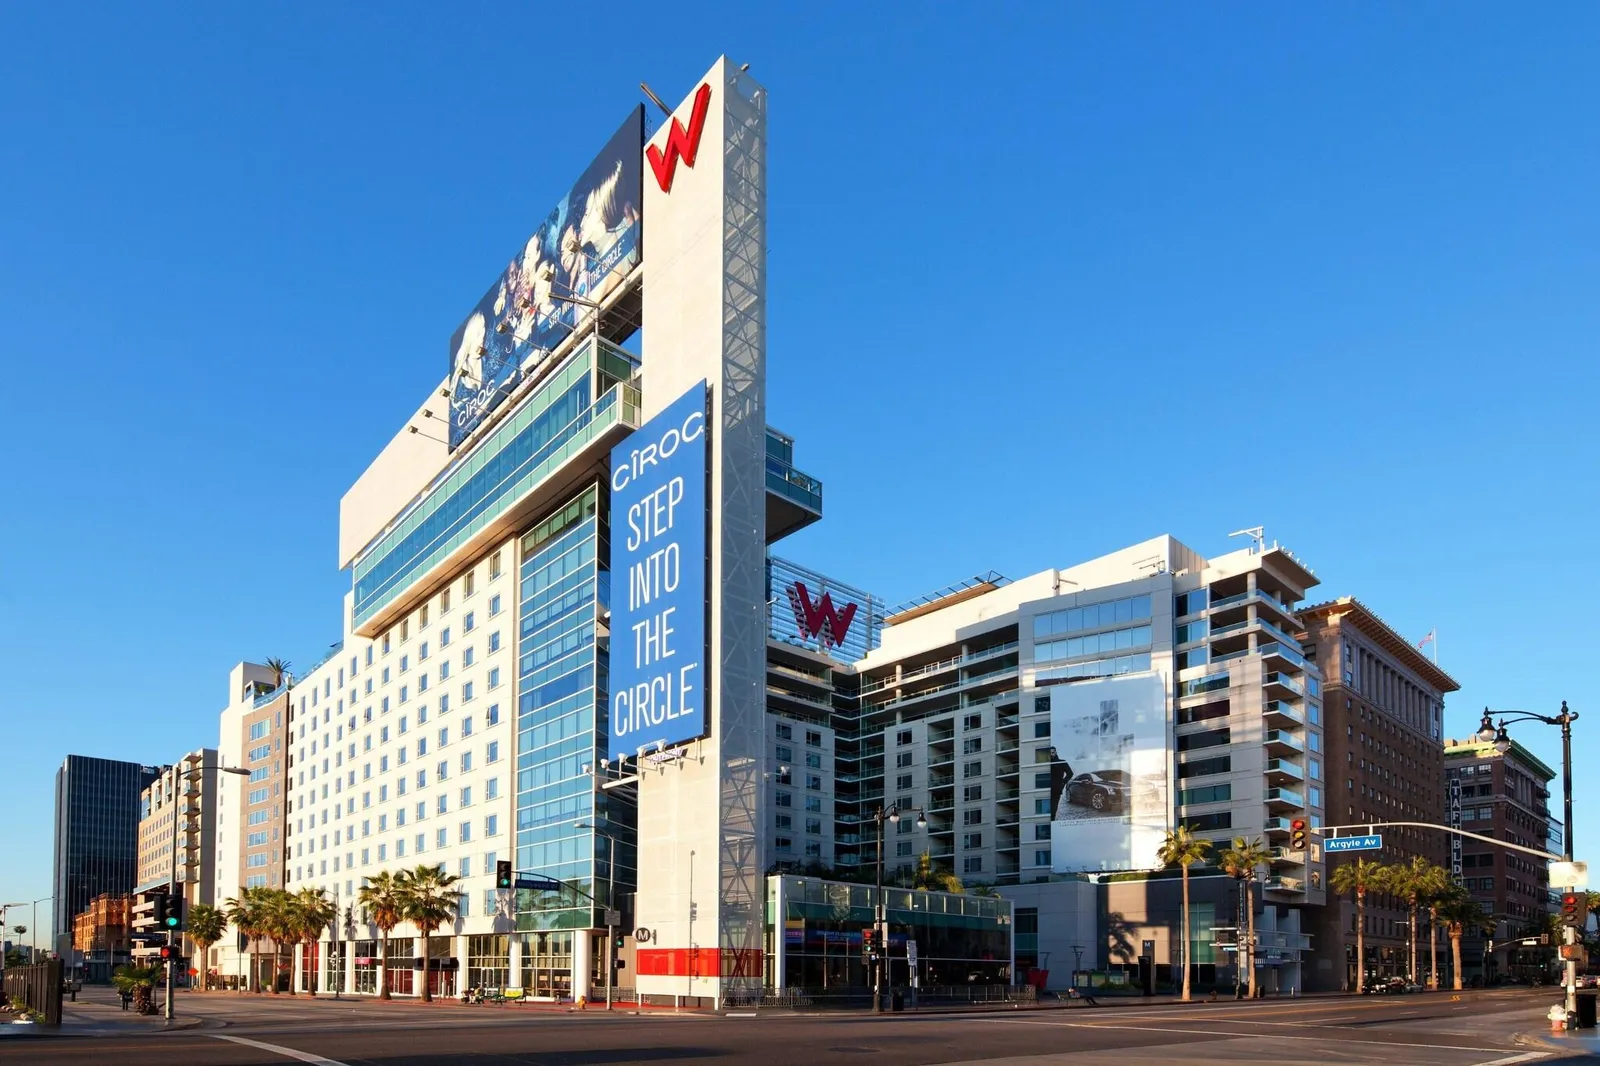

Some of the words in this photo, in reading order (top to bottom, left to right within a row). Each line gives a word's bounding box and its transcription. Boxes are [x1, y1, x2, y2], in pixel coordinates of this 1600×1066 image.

[646, 82, 711, 193] W
[590, 265, 602, 285] THE
[602, 243, 622, 273] CIRCLE
[628, 476, 684, 552] STEP
[629, 542, 680, 612] INTO
[632, 607, 676, 670] THE
[793, 580, 858, 648] W
[614, 664, 696, 737] CIRCLE
[1330, 839, 1361, 849] Argyle
[1364, 838, 1376, 846] Av
[638, 930, 648, 940] M
